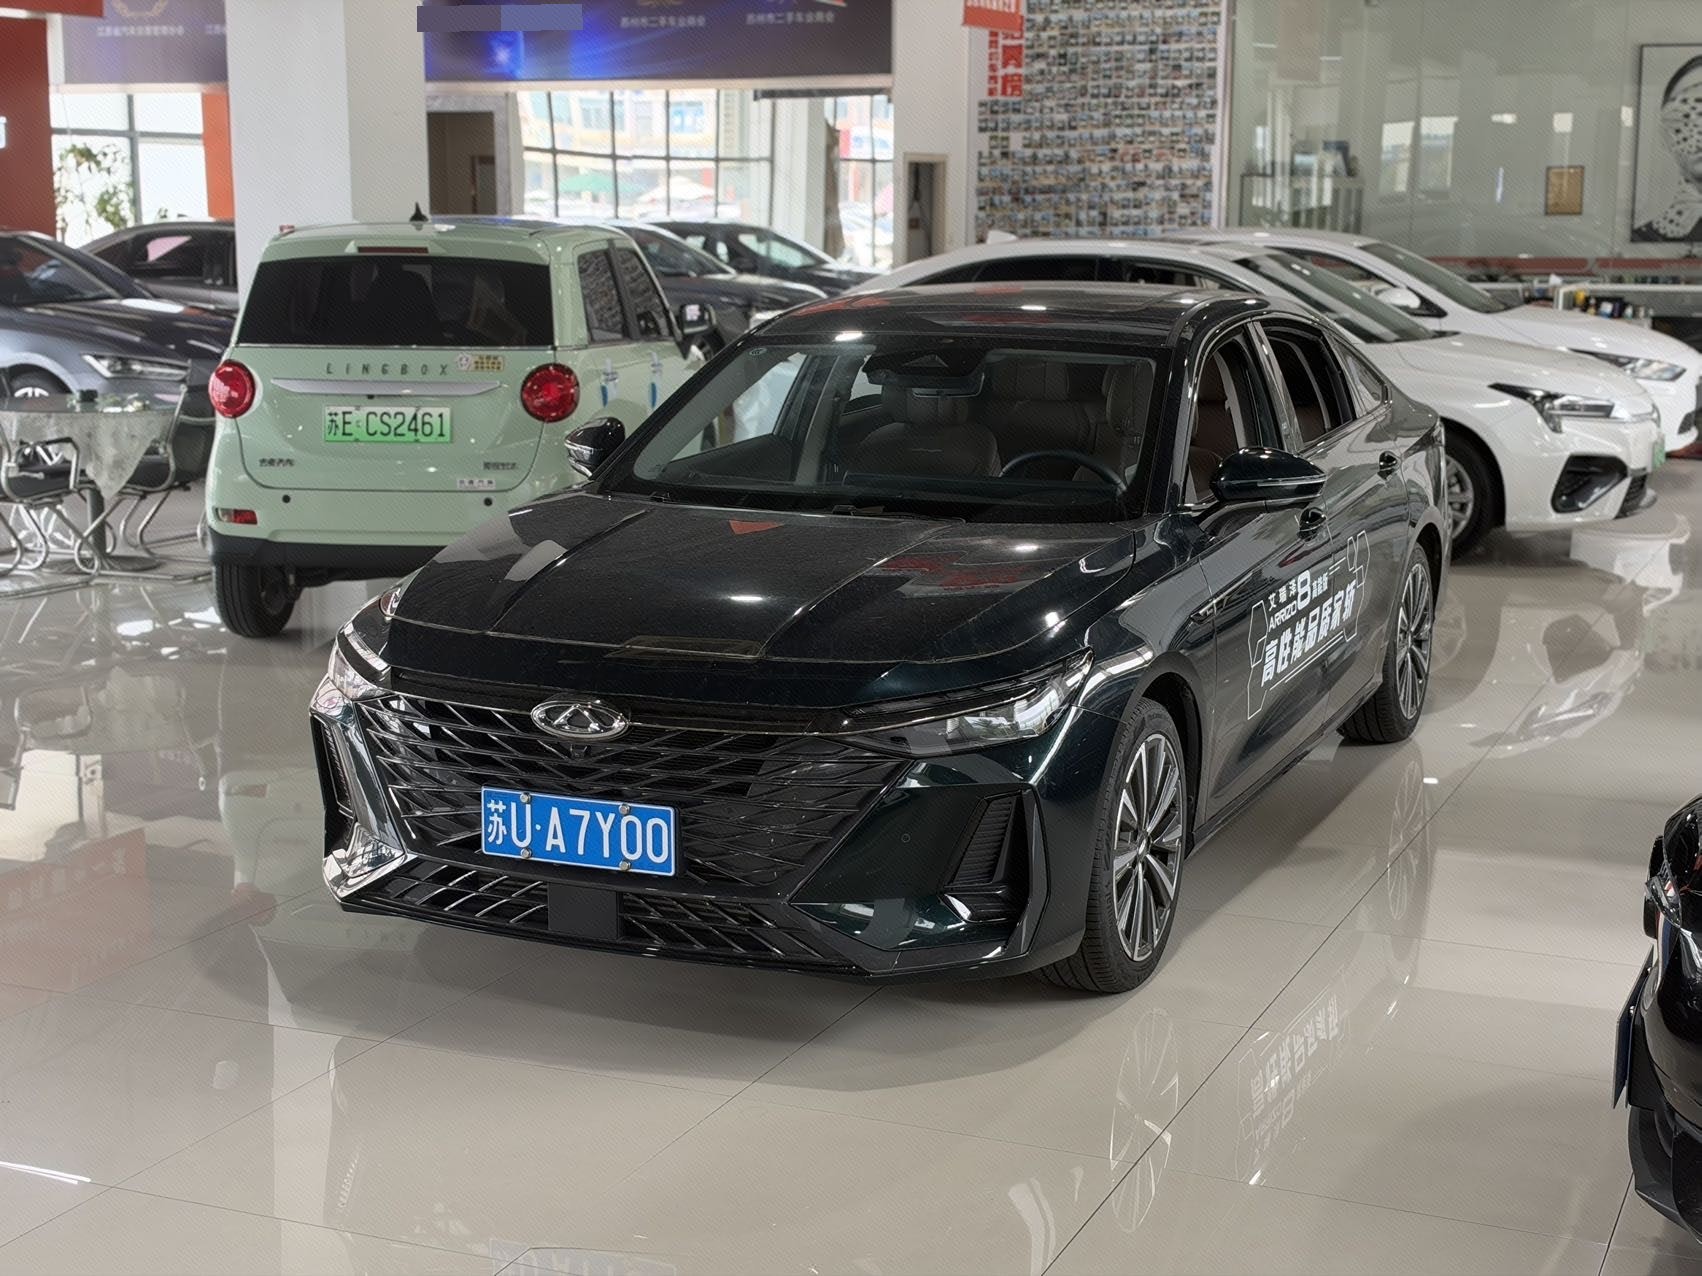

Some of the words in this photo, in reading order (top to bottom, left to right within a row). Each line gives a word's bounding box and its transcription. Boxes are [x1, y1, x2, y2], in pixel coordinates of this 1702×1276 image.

[326, 363, 448, 376] LINGBOX
[1268, 600, 1298, 633] ARRIZO
[486, 799, 669, 864] 苏U·A7Y00
